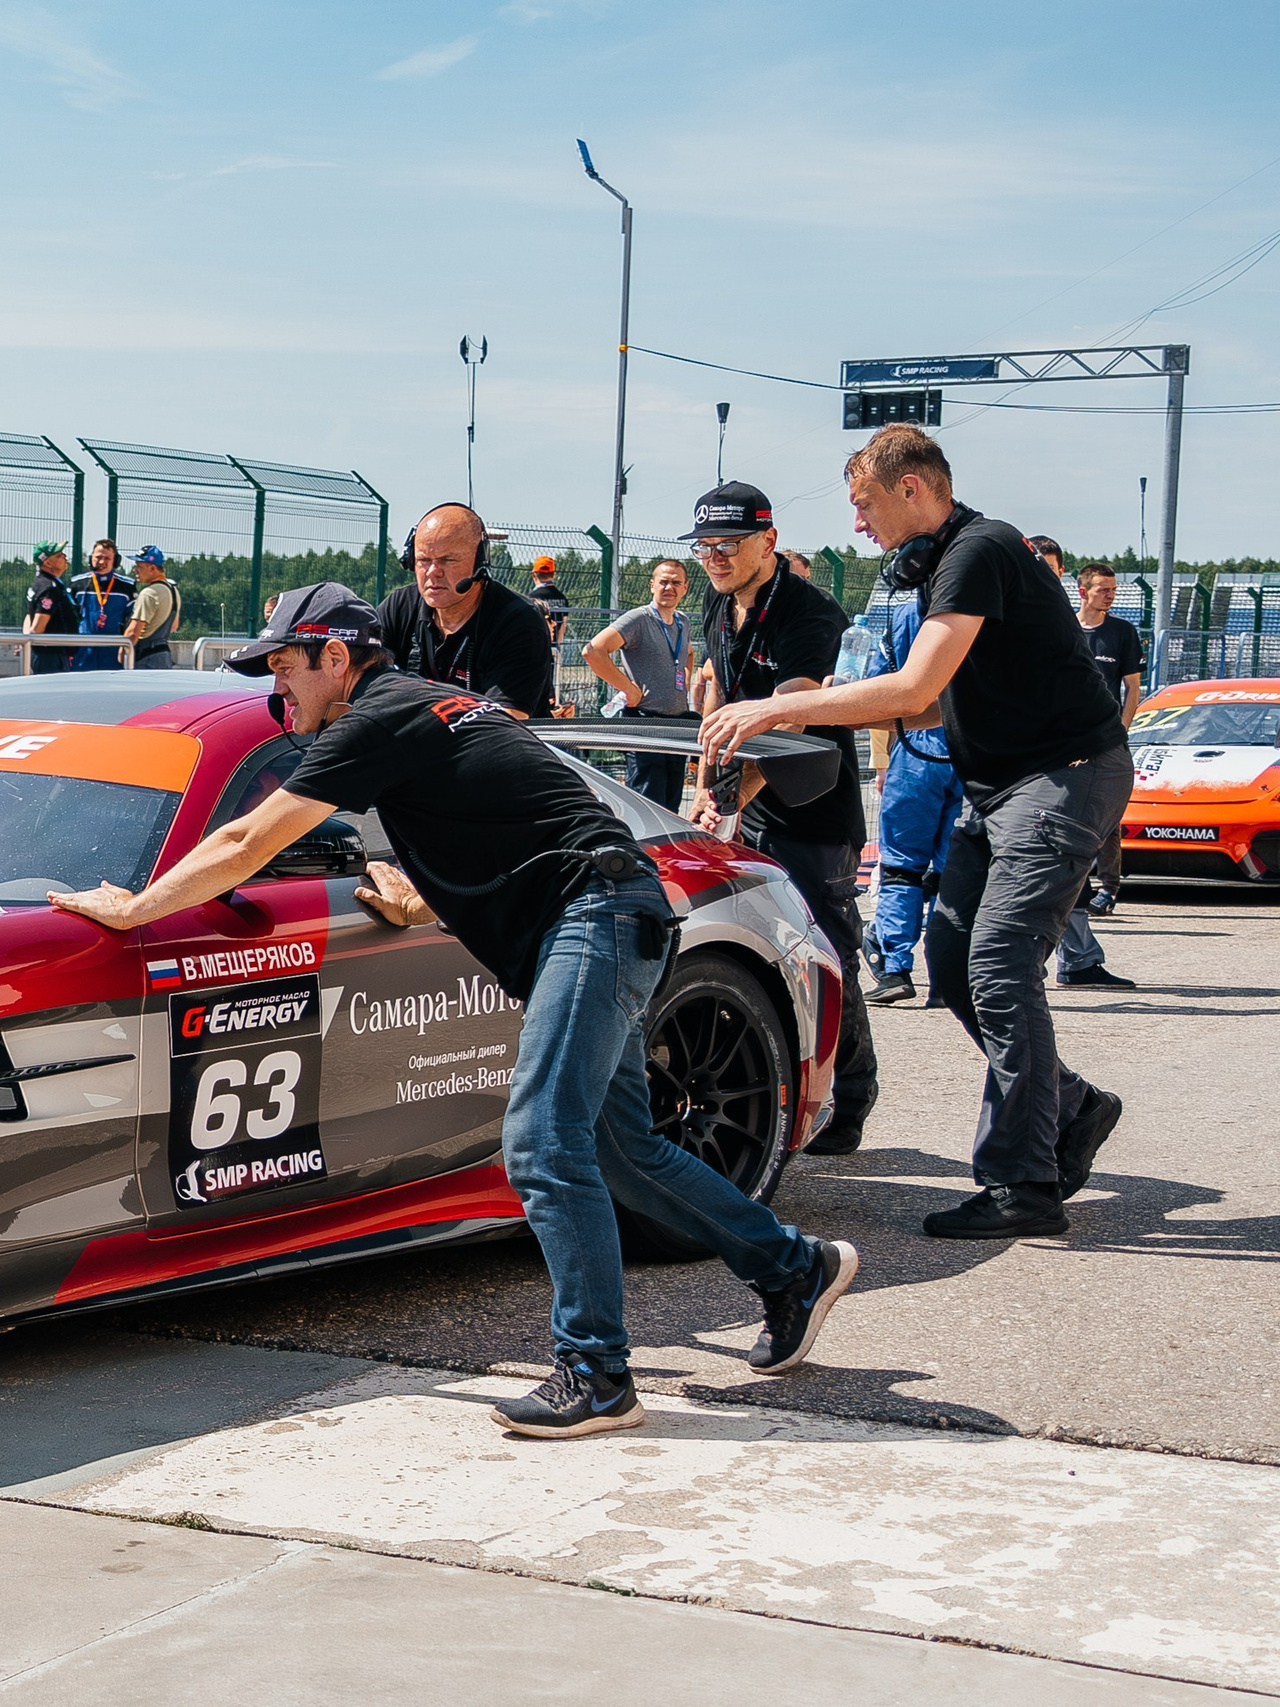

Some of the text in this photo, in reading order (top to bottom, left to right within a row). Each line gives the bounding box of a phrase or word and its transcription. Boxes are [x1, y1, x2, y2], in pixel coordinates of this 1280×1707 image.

[901, 366, 949, 375] SMP RACING
[1145, 826, 1216, 840] YOKOHAMA
[182, 942, 316, 981] В.МЕЩЕРЯКОВ
[235, 990, 310, 1008] МОТОРНОЕ МАСЛО
[408, 1043, 507, 1071] Официальный дилер
[191, 1050, 301, 1149] 63
[396, 1067, 515, 1104] Mercedes-Benz
[205, 1150, 322, 1191] SMP RACING
